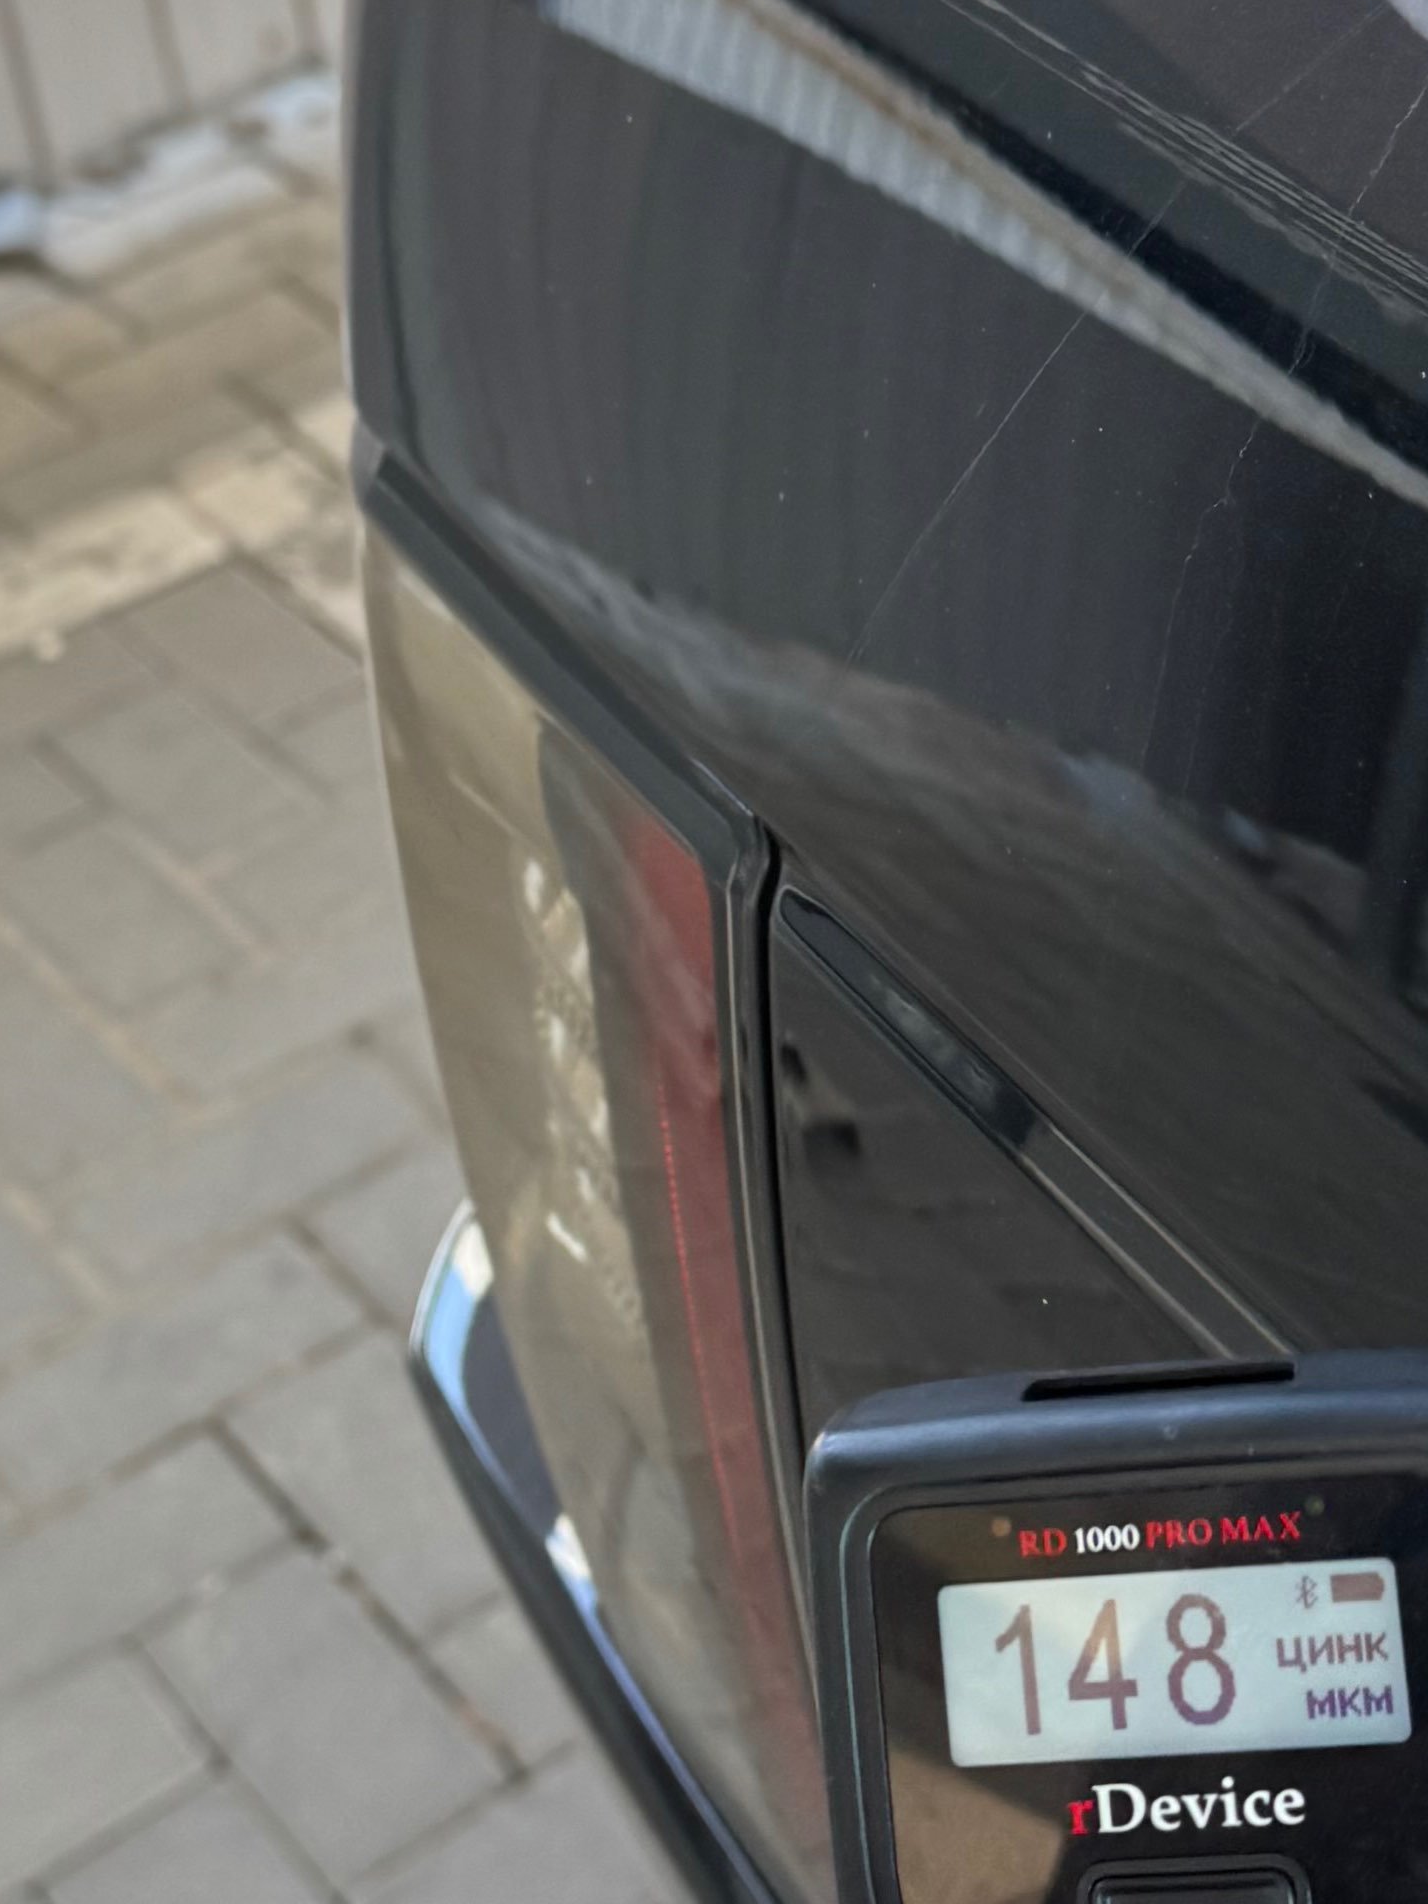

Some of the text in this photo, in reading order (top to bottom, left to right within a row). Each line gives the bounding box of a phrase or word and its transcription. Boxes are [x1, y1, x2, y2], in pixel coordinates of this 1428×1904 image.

[1019, 1511, 1303, 1557] RD 1000 PRO MAX
[995, 1593, 1236, 1737] 148
[1067, 1776, 1306, 1836] rDevice
